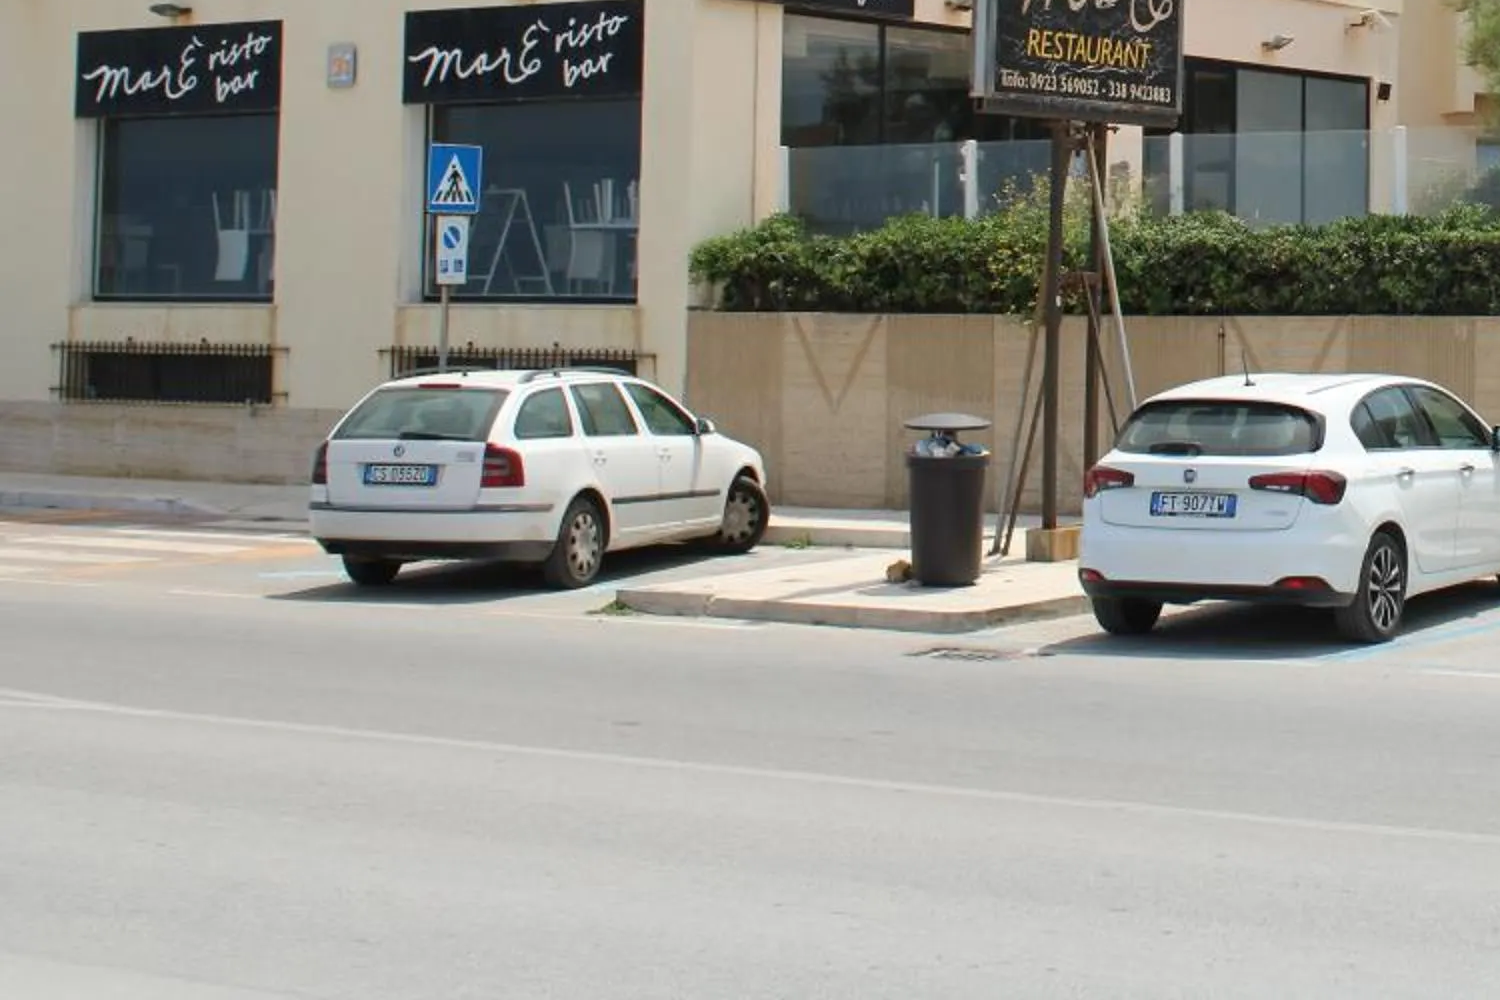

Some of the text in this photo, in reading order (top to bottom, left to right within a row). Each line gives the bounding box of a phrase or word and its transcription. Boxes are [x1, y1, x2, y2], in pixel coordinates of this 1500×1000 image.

[555, 12, 628, 53] risto
[1026, 28, 1153, 70] RESTAURANT
[208, 32, 272, 70] risto
[215, 69, 259, 103] bar
[563, 53, 613, 88] bar
[1030, 72, 1057, 91] 0923
